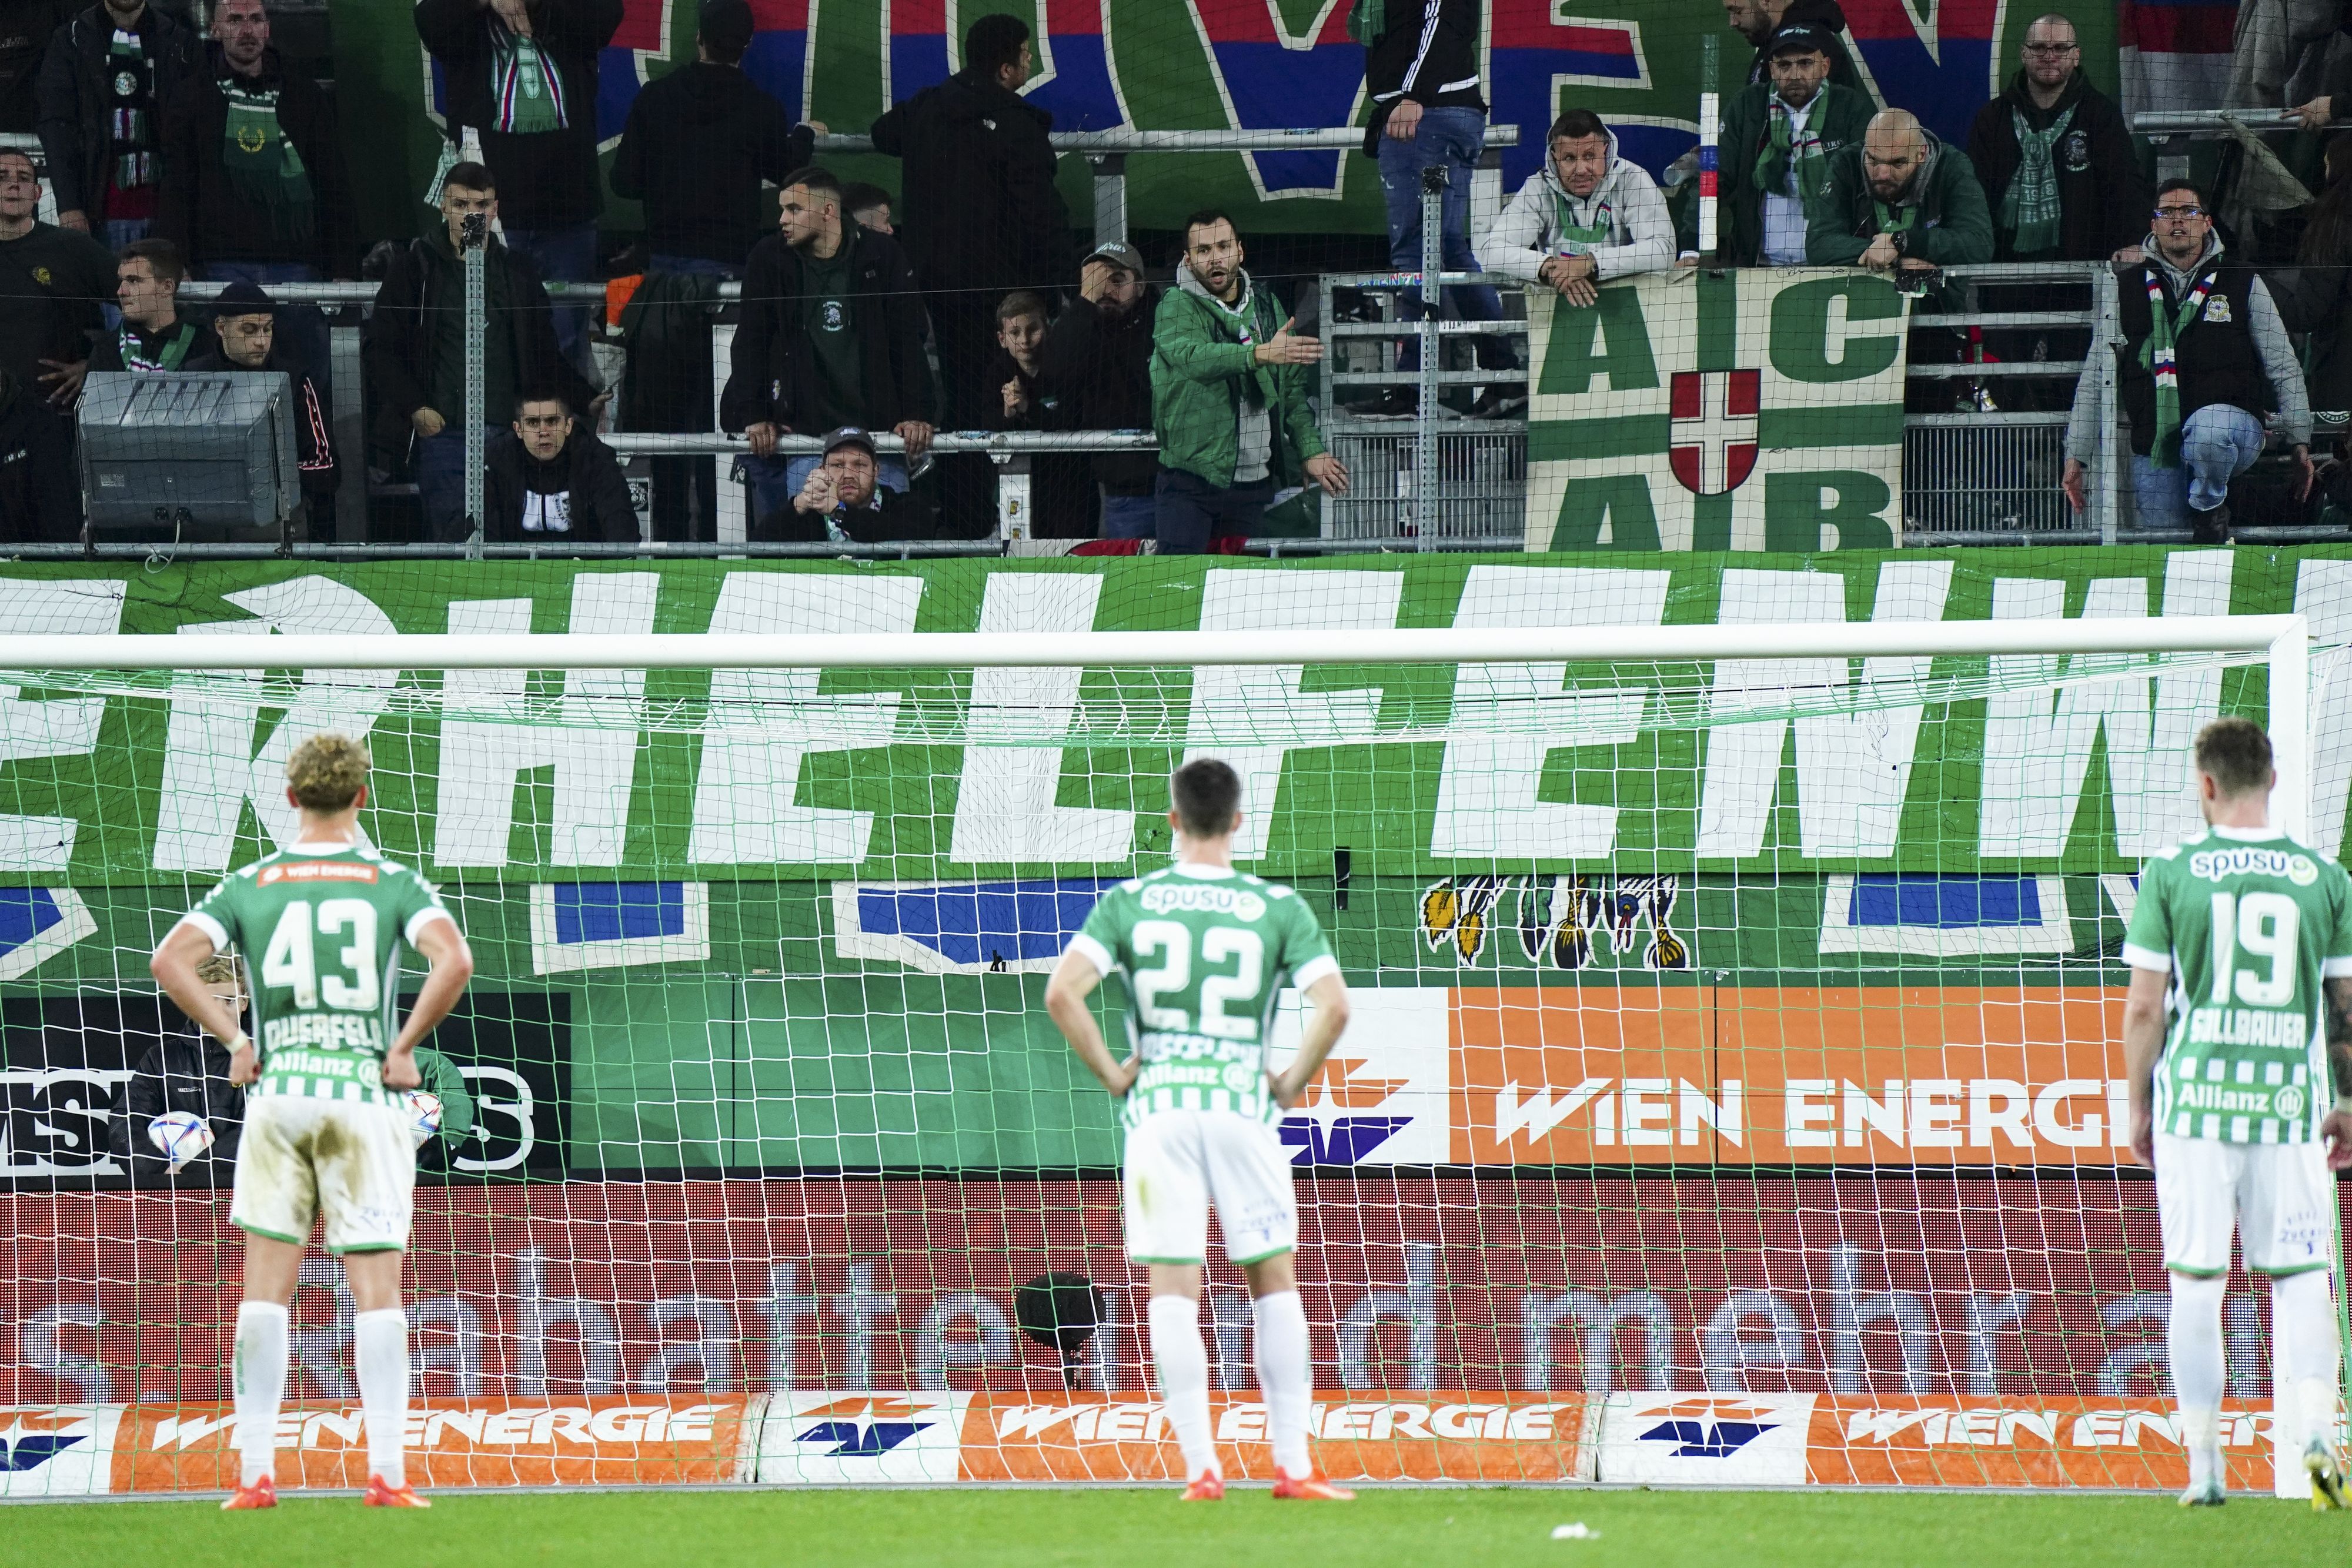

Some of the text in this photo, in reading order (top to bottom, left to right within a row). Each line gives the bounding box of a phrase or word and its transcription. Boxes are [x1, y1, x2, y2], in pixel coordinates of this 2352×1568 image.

[2193, 850, 2287, 877] spusu
[1145, 885, 1234, 909] spusu
[262, 898, 380, 1011] 43
[2211, 891, 2300, 1007] 19
[1132, 920, 1264, 1039] 22
[268, 1051, 355, 1077] Allianz
[1136, 1062, 1220, 1095] Allianz
[1496, 1077, 2131, 1148] WIEN ENERGI
[2177, 1082, 2270, 1113] Allianz
[1524, 1242, 2031, 1396] mehr
[1847, 1407, 2059, 1446] WIEN
